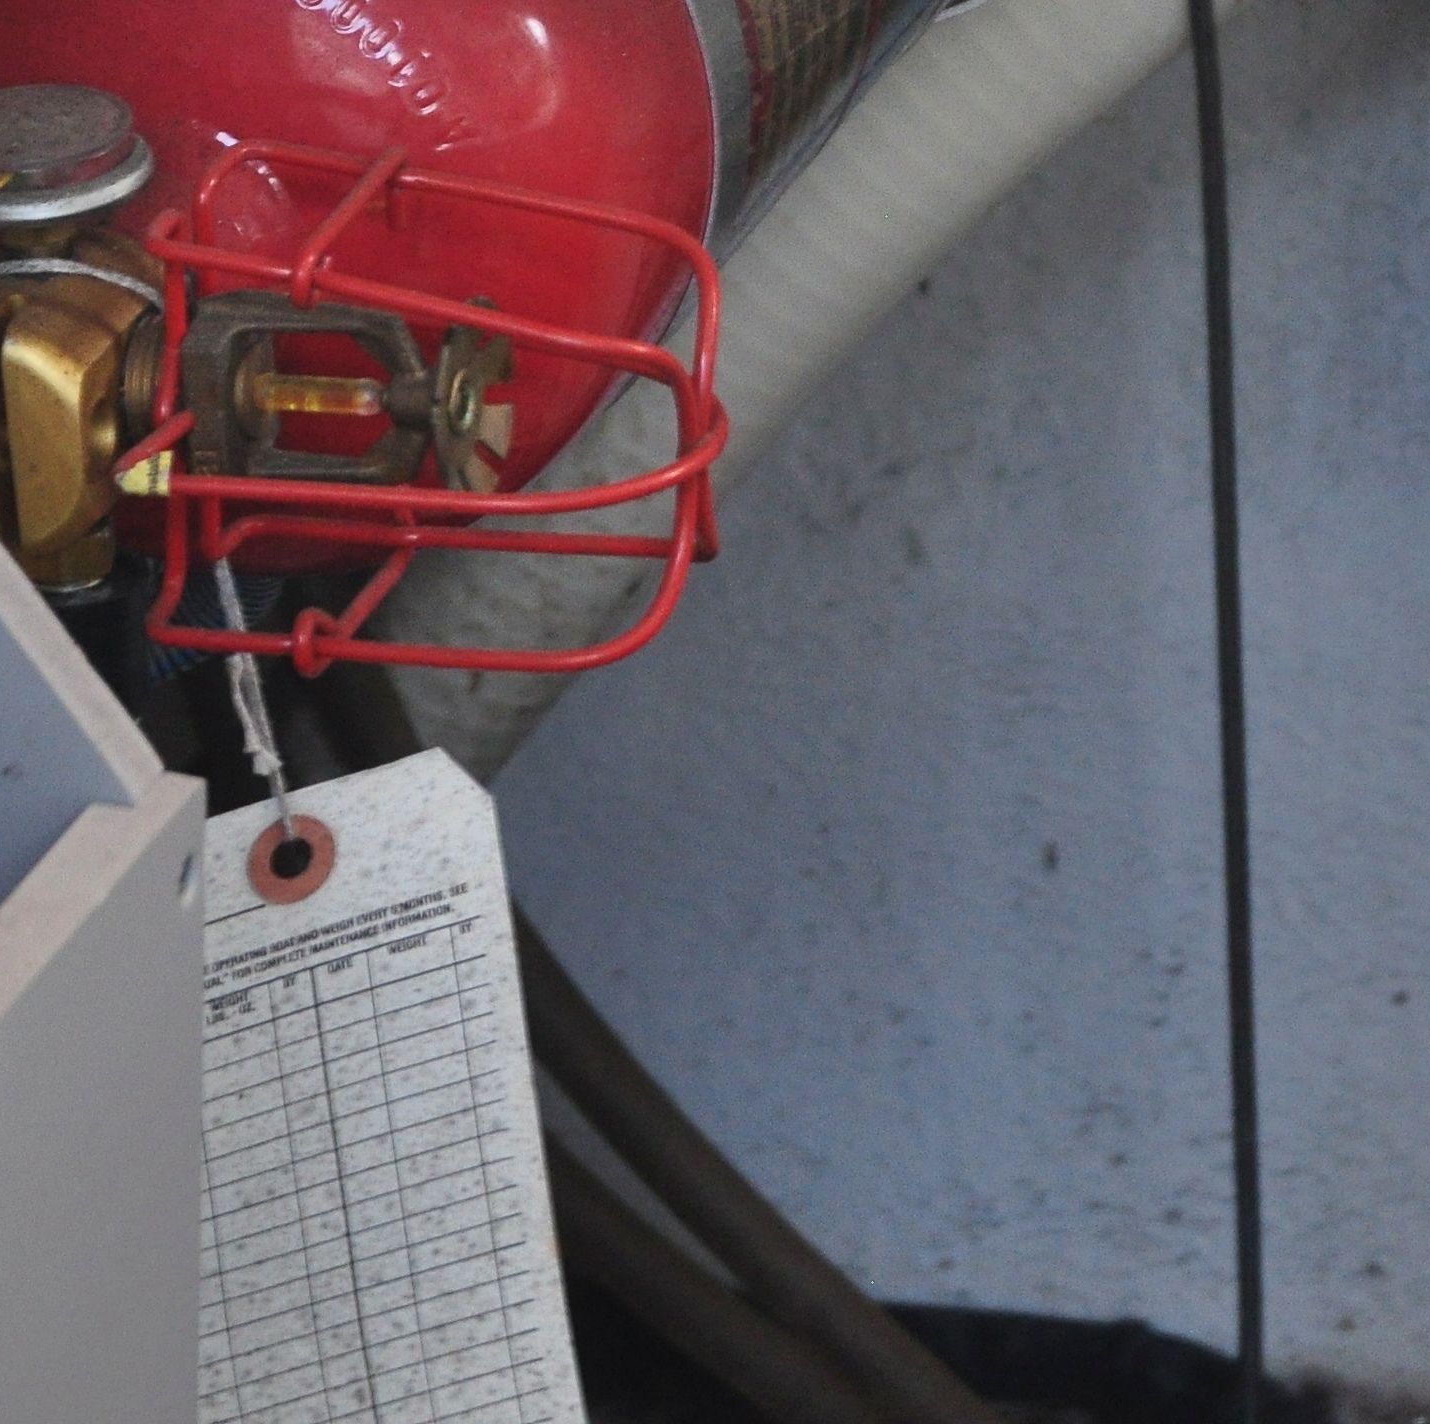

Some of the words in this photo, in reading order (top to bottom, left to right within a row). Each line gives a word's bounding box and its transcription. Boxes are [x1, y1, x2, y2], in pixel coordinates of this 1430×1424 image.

[297, 929, 318, 945] AND
[320, 917, 354, 935] WEIGH
[356, 906, 388, 926] EVERY
[449, 882, 468, 897] SEE
[232, 965, 252, 981] FOR
[254, 948, 305, 974] COMPLETE
[310, 924, 378, 954] MAINTENANCE
[387, 936, 427, 955] WEIGHT
[328, 956, 353, 974] DATE
